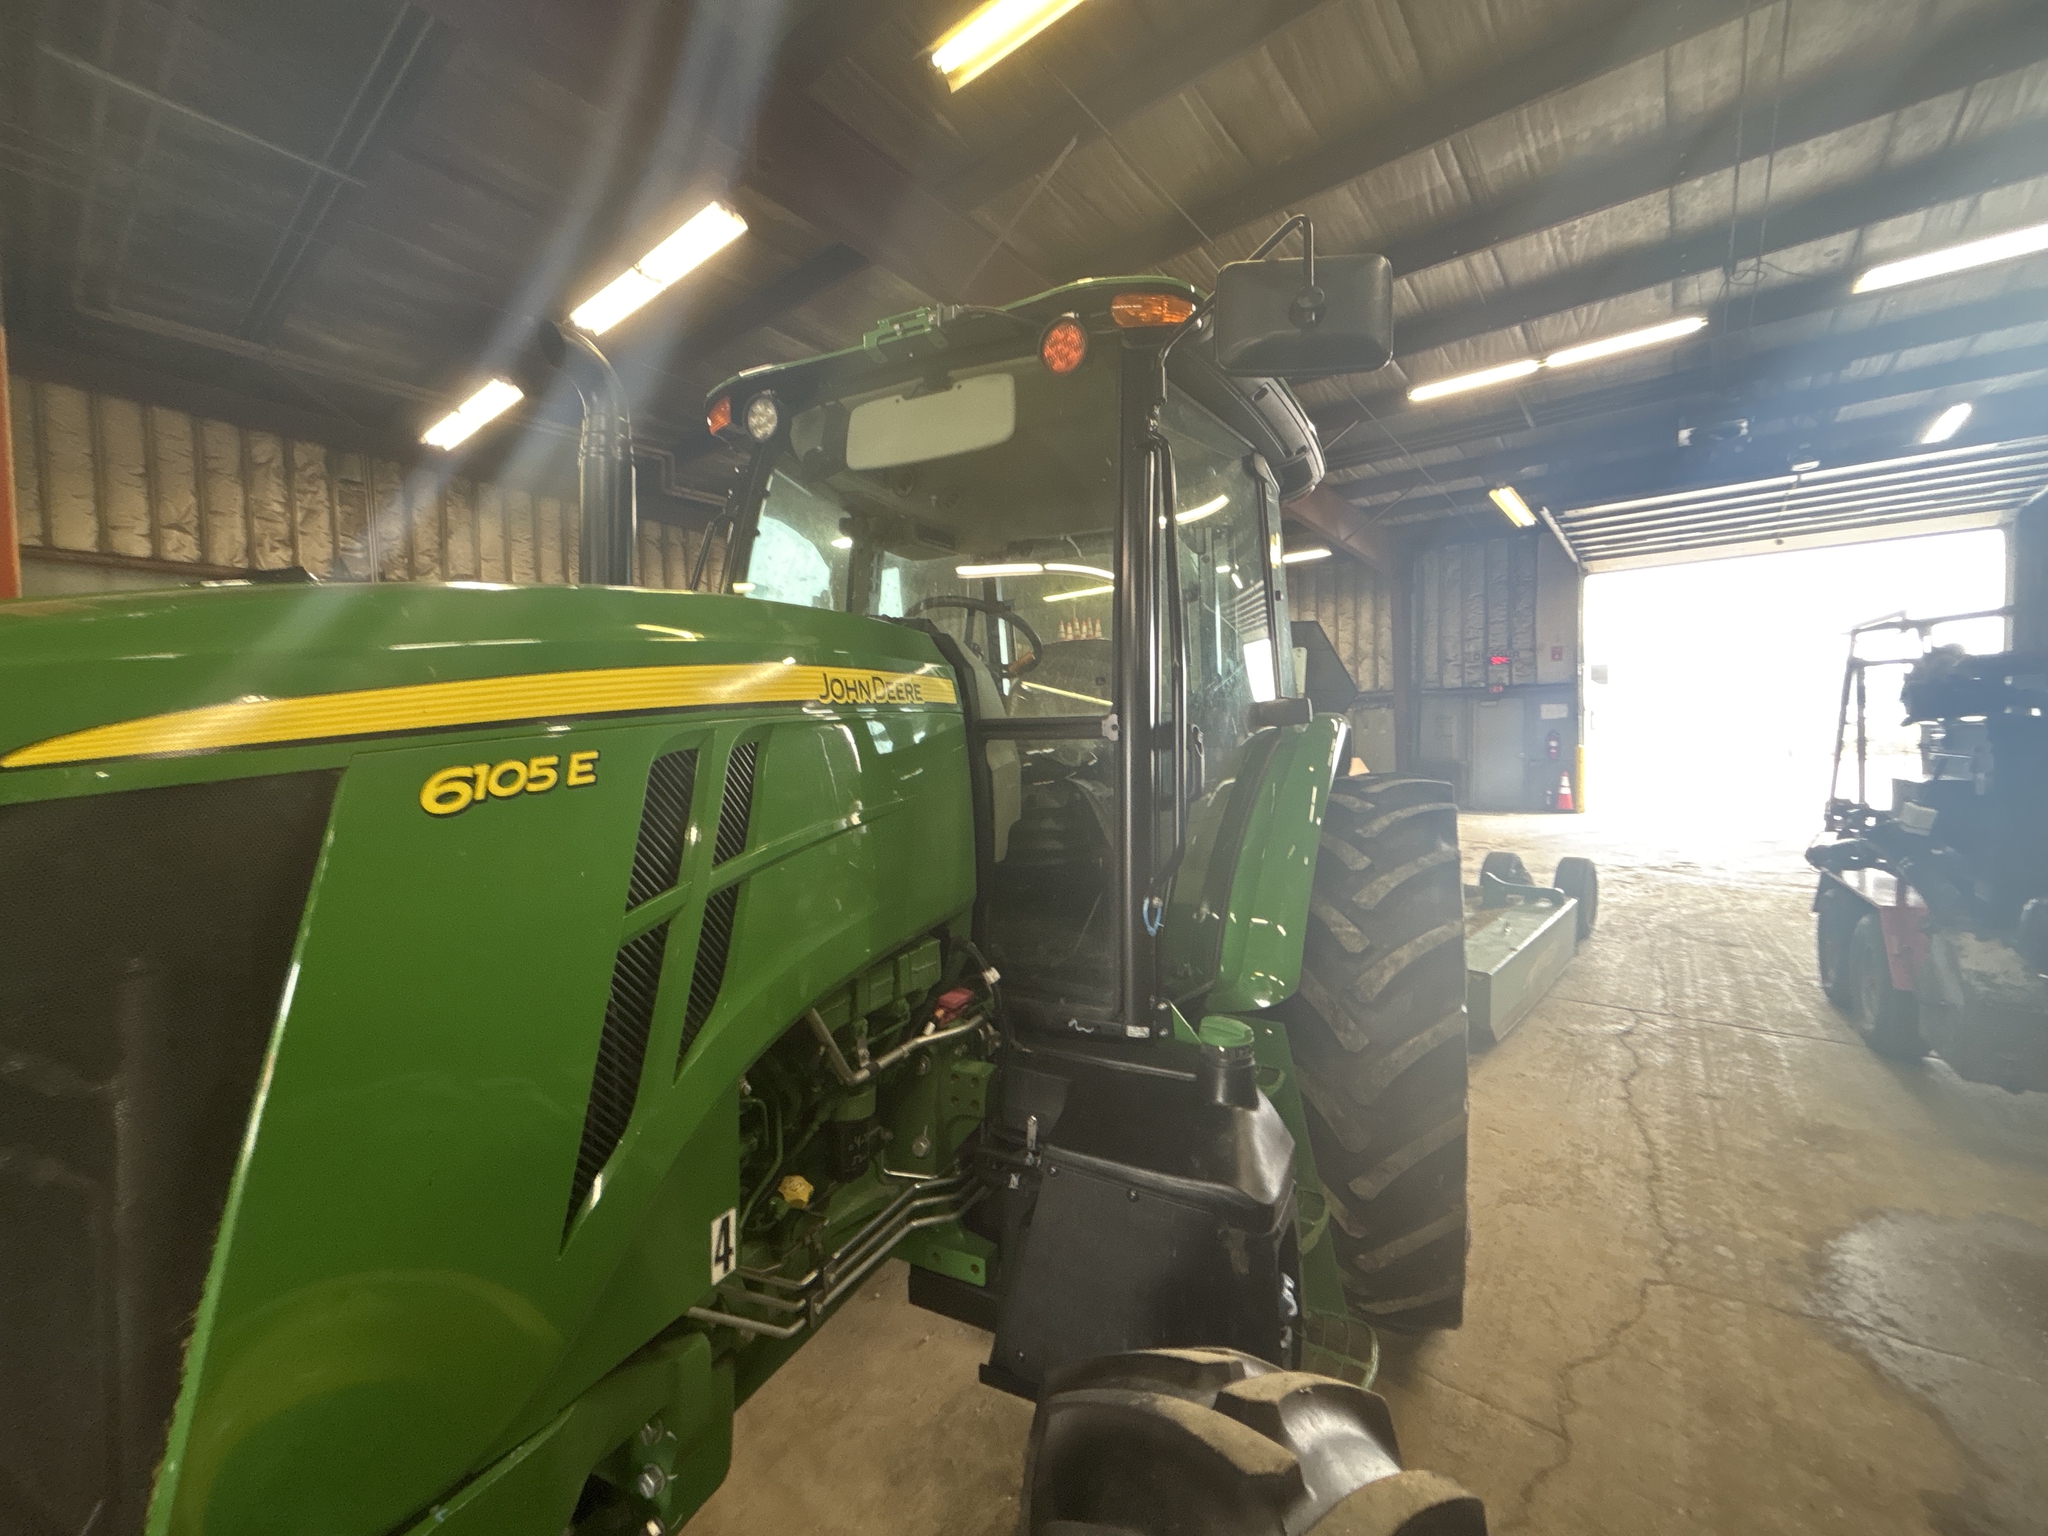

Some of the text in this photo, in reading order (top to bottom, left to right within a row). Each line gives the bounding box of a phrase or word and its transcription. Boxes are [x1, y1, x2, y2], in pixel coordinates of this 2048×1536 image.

[819, 672, 923, 701] JOHN DEERE
[420, 750, 599, 816] 6105 E
[715, 1214, 734, 1273] 4
